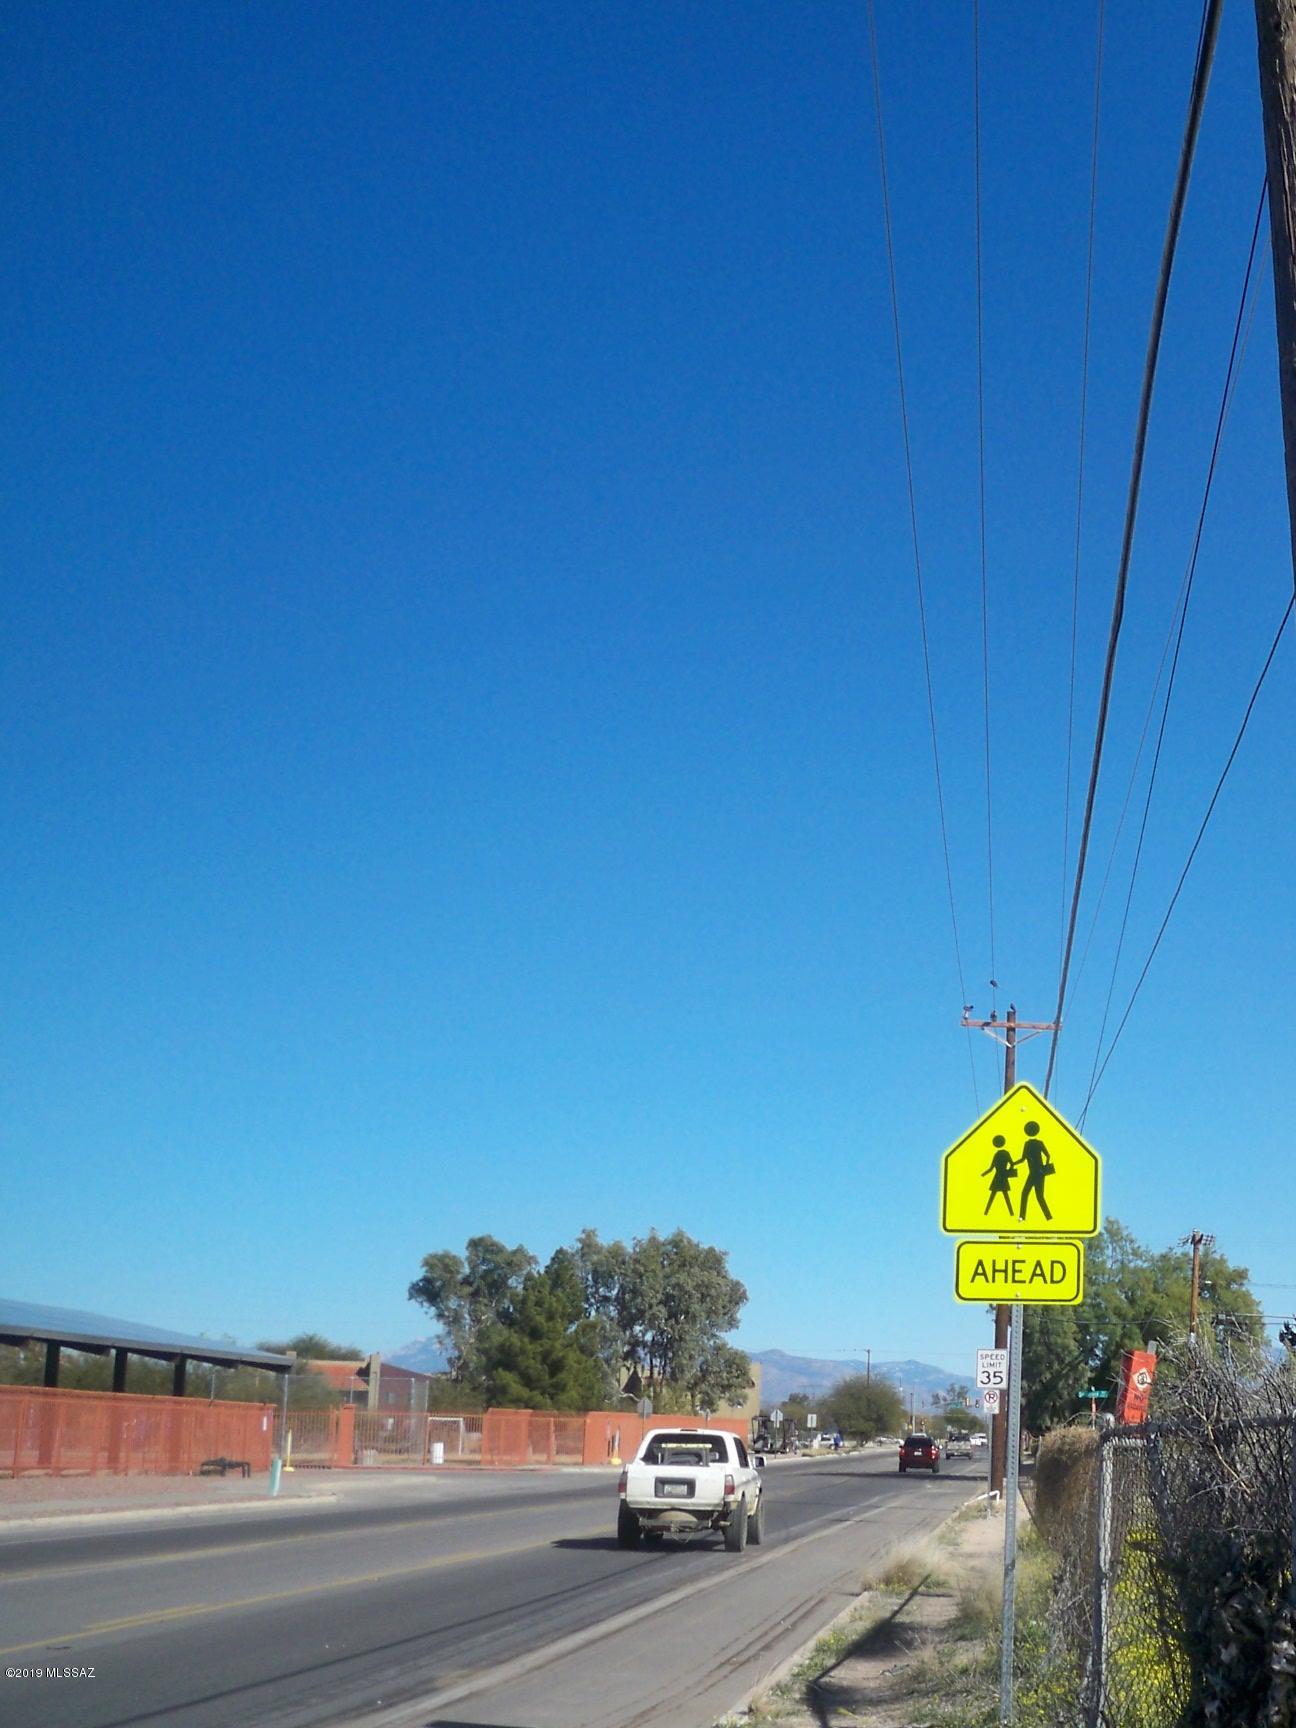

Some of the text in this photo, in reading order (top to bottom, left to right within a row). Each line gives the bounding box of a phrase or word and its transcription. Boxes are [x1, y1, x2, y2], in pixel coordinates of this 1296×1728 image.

[970, 1259, 1067, 1284] AHEAD
[980, 1353, 1005, 1361] SPEED
[982, 1361, 1002, 1369] LIMIT
[980, 1370, 1003, 1385] 35
